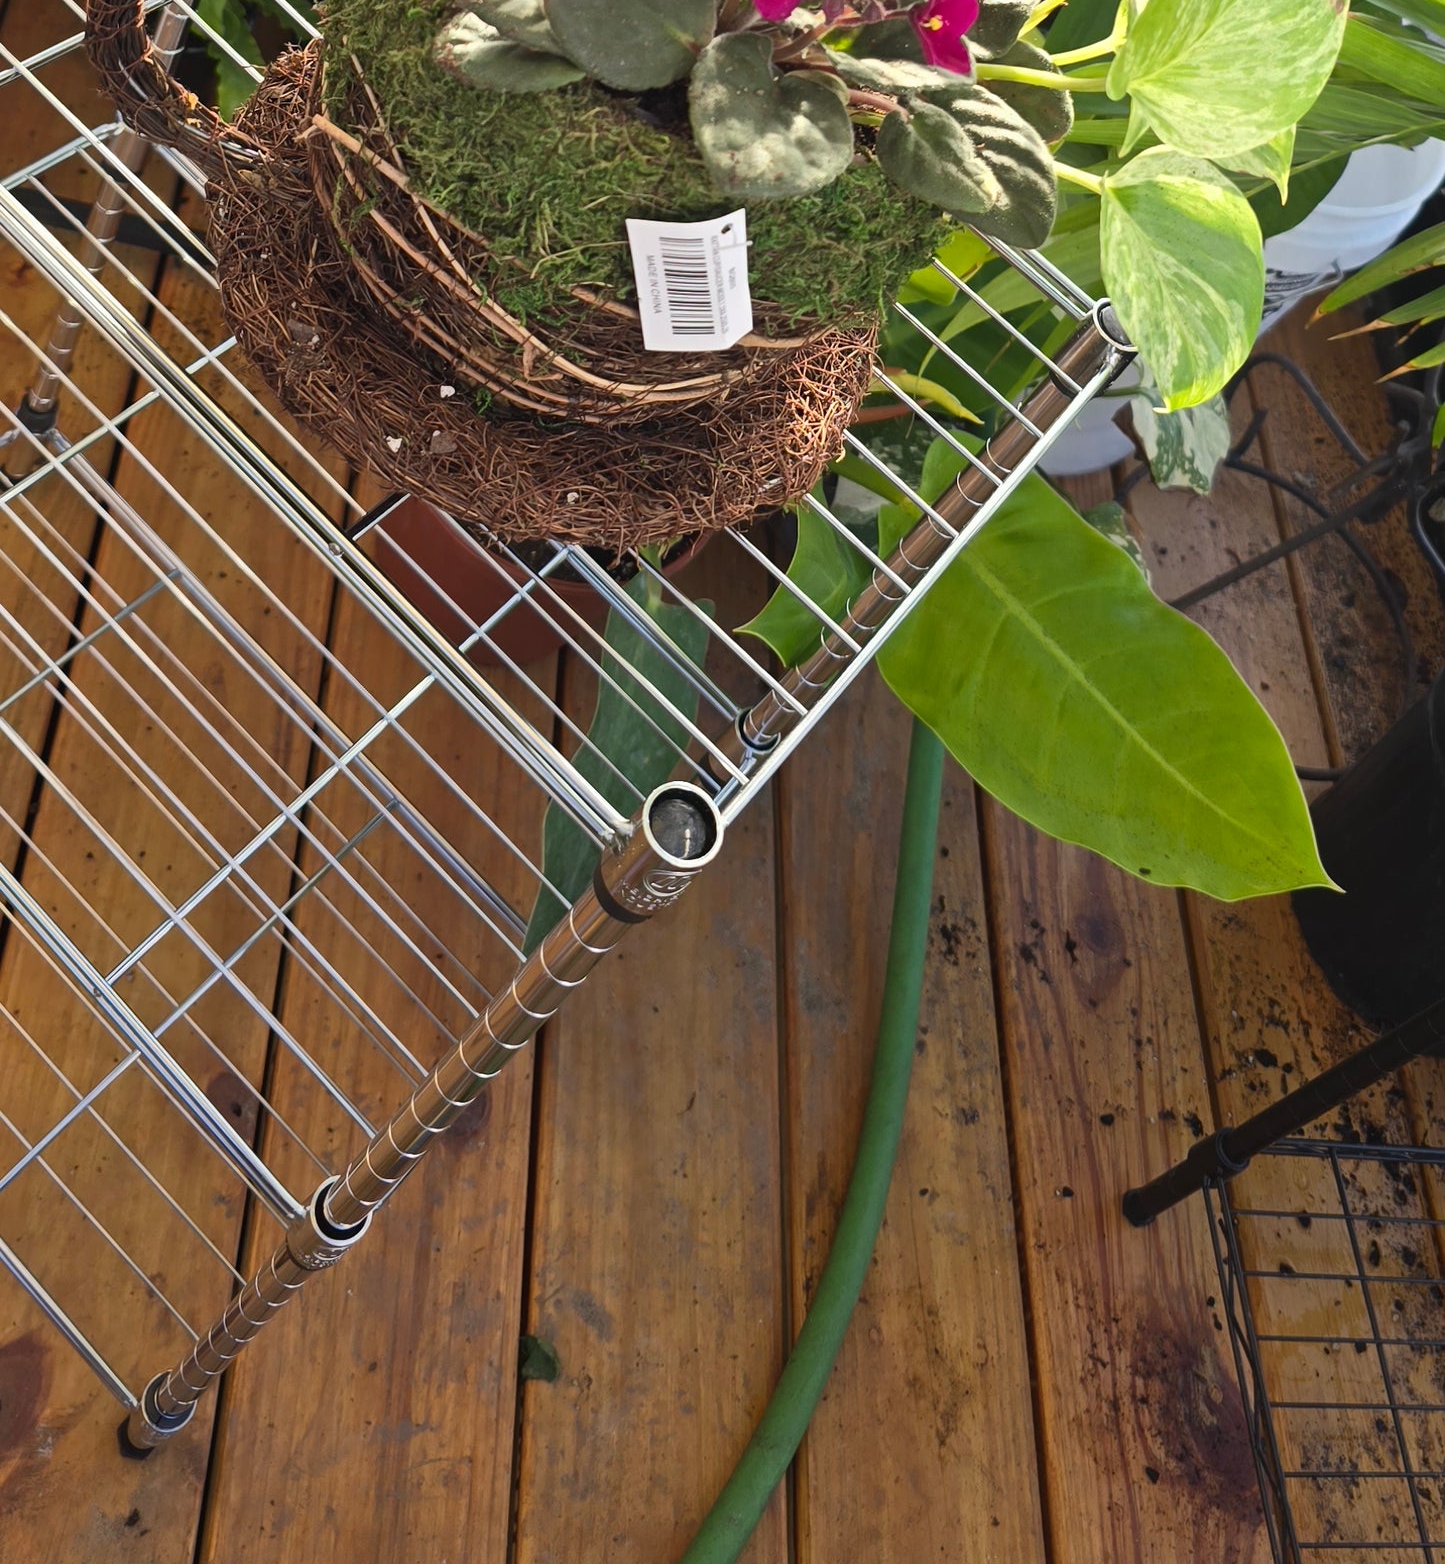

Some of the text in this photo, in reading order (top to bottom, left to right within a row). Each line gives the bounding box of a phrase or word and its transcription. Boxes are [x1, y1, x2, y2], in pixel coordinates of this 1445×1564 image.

[646, 255, 662, 314] MADE IN CHINA
